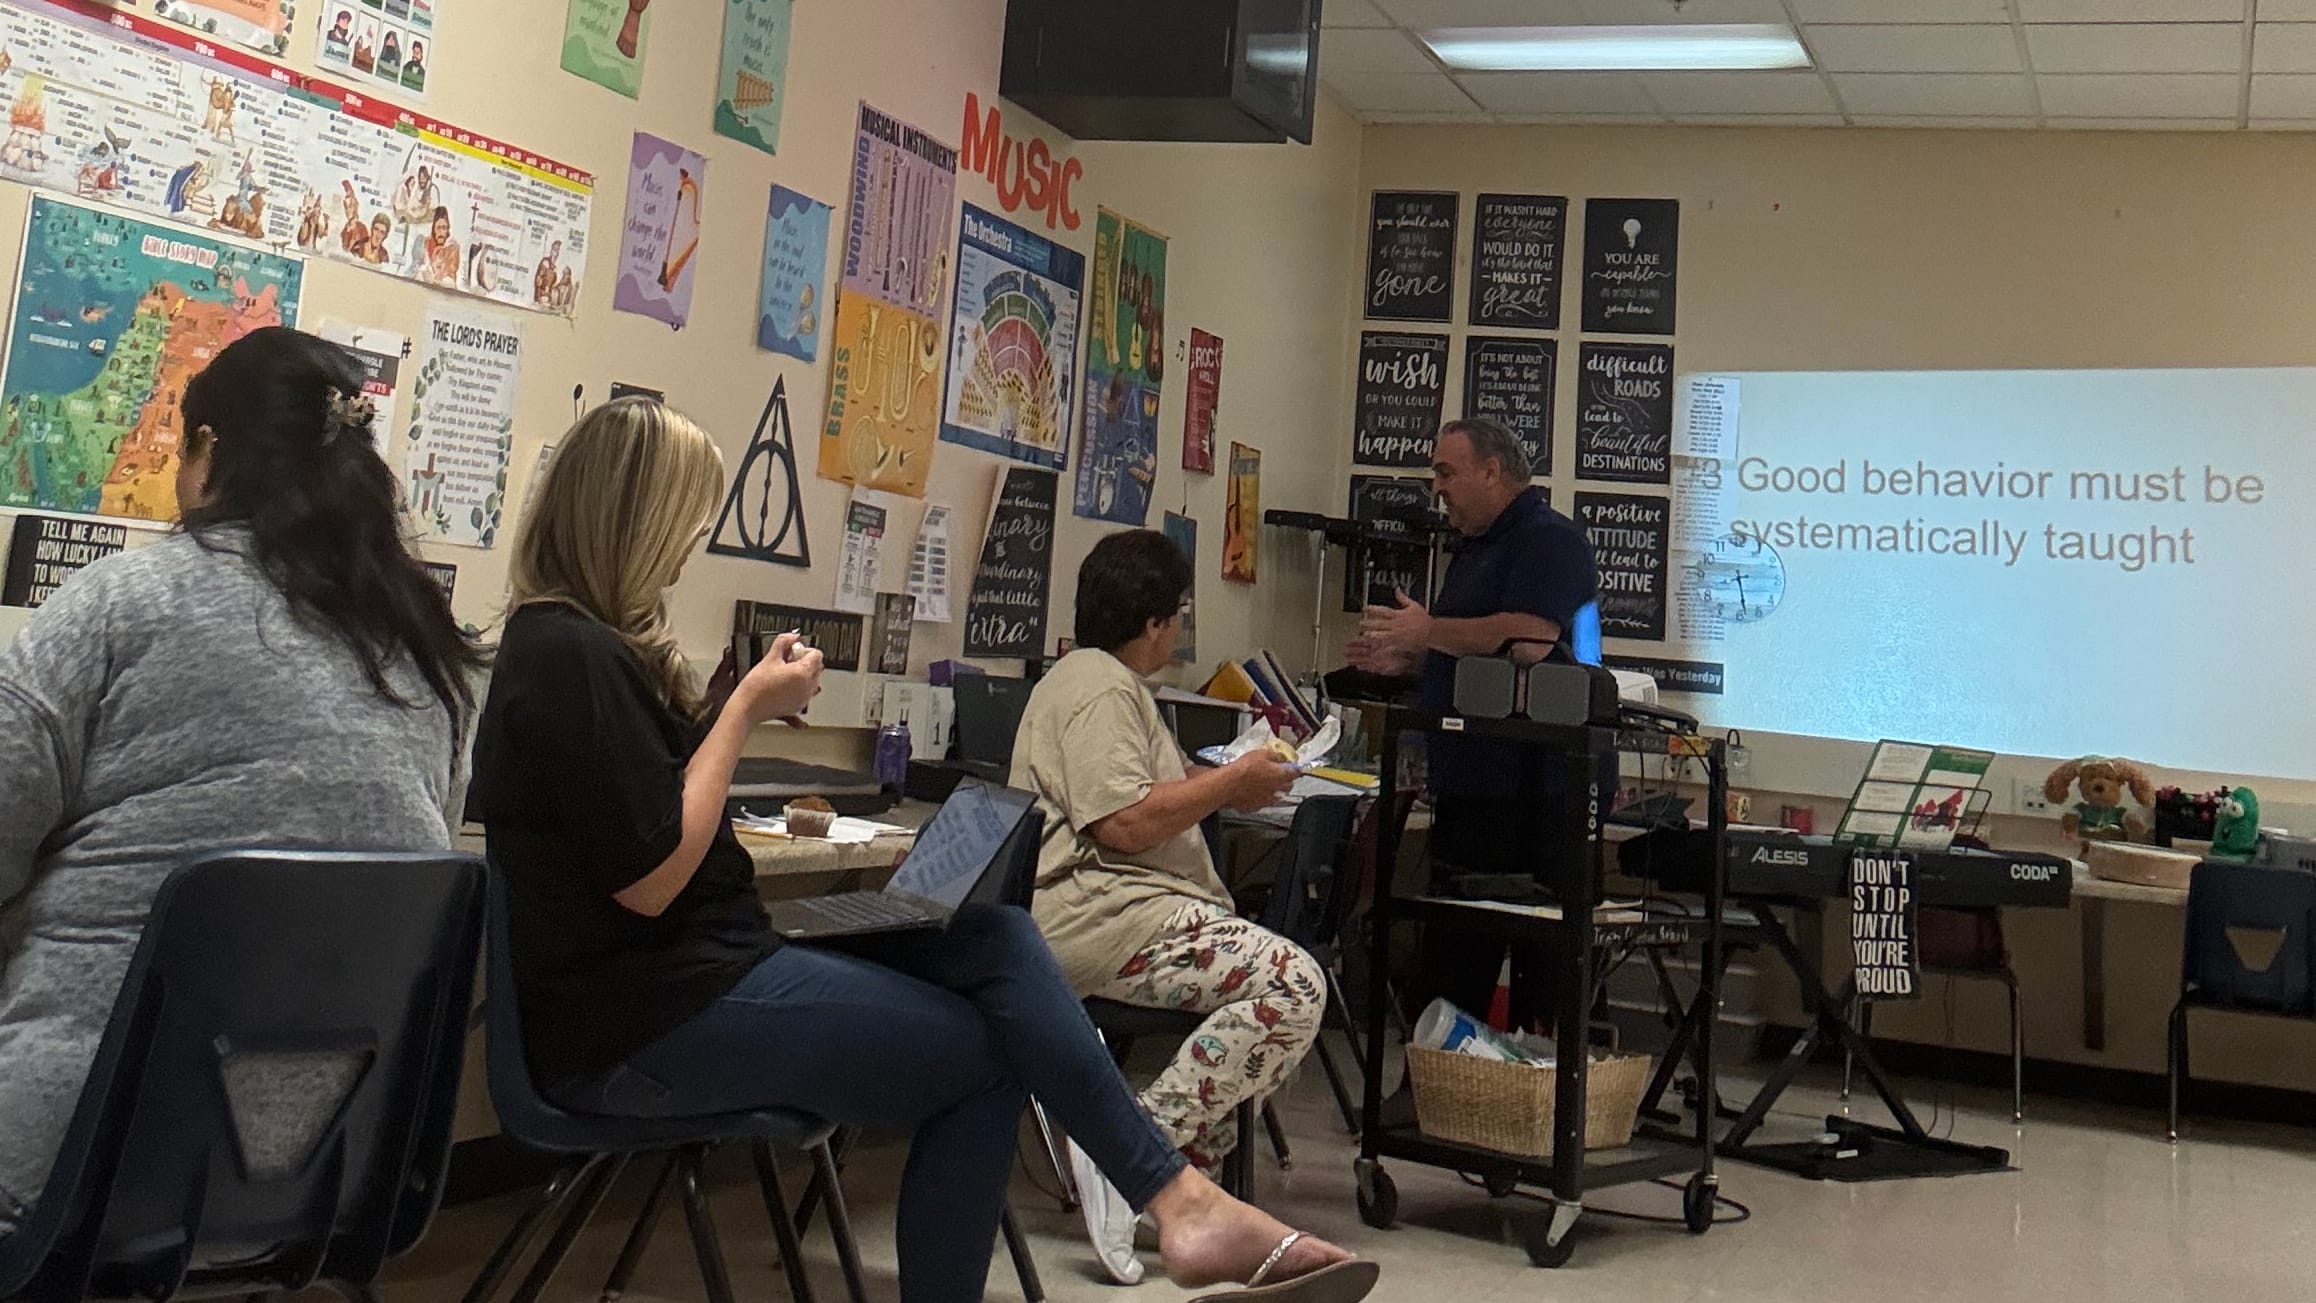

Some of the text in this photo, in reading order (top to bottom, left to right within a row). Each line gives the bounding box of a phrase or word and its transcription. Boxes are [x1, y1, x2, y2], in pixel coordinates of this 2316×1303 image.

[861, 105, 957, 176] MUSICAL INSTRUMENTS
[962, 93, 1083, 231] MUSIC
[847, 136, 870, 277] WOODWIND
[964, 213, 978, 238] The
[978, 220, 1012, 253] Orchestra
[168, 241, 197, 264] STORY
[1483, 242, 1554, 258] WOULD DO IT
[1604, 253, 1660, 265] YOU ARE
[1373, 268, 1446, 306] gone
[1492, 272, 1543, 285] MAKES IT
[1597, 265, 1663, 285] capable
[1481, 285, 1549, 318] great
[432, 319, 519, 356] THE LORD'S PRAYER
[1365, 351, 1440, 390] wish
[1498, 353, 1514, 363] NOT
[1586, 353, 1667, 377] difficult
[826, 347, 850, 437] BRASS
[1614, 379, 1661, 397] ROADS
[1381, 395, 1402, 406] YOU
[1405, 396, 1435, 407] COULD
[1378, 415, 1421, 429] MAKE IT
[1584, 410, 1611, 422] lead
[1076, 379, 1098, 506] PERCUSSION
[1359, 430, 1434, 461] happen
[1589, 425, 1667, 454] beautiful
[1583, 454, 1665, 472] DESTINATIONS
[1738, 456, 1846, 493] Good
[1863, 460, 2053, 498] behavior
[2070, 465, 2186, 502] must
[2204, 464, 2265, 504] be
[1582, 504, 1661, 523] a positive
[42, 519, 125, 545] TELL ME AGAIN
[1586, 526, 1658, 549] ATTITUDE
[1730, 516, 2195, 572] systematically taught
[36, 540, 64, 561] HOW
[64, 542, 98, 564] LUCKY
[1610, 550, 1640, 568] lead
[1643, 553, 1660, 569] to
[34, 564, 48, 583] TO
[1667, 667, 1722, 687] Yesterday
[1751, 846, 1809, 866] ALESIS
[1853, 858, 1909, 886] DON'T
[2010, 863, 2050, 882] CODA
[1853, 885, 1910, 912] STOP
[1852, 913, 1908, 939] UNTIL
[1853, 940, 1909, 966] YOU'RE
[1855, 967, 1912, 993] PROUD
